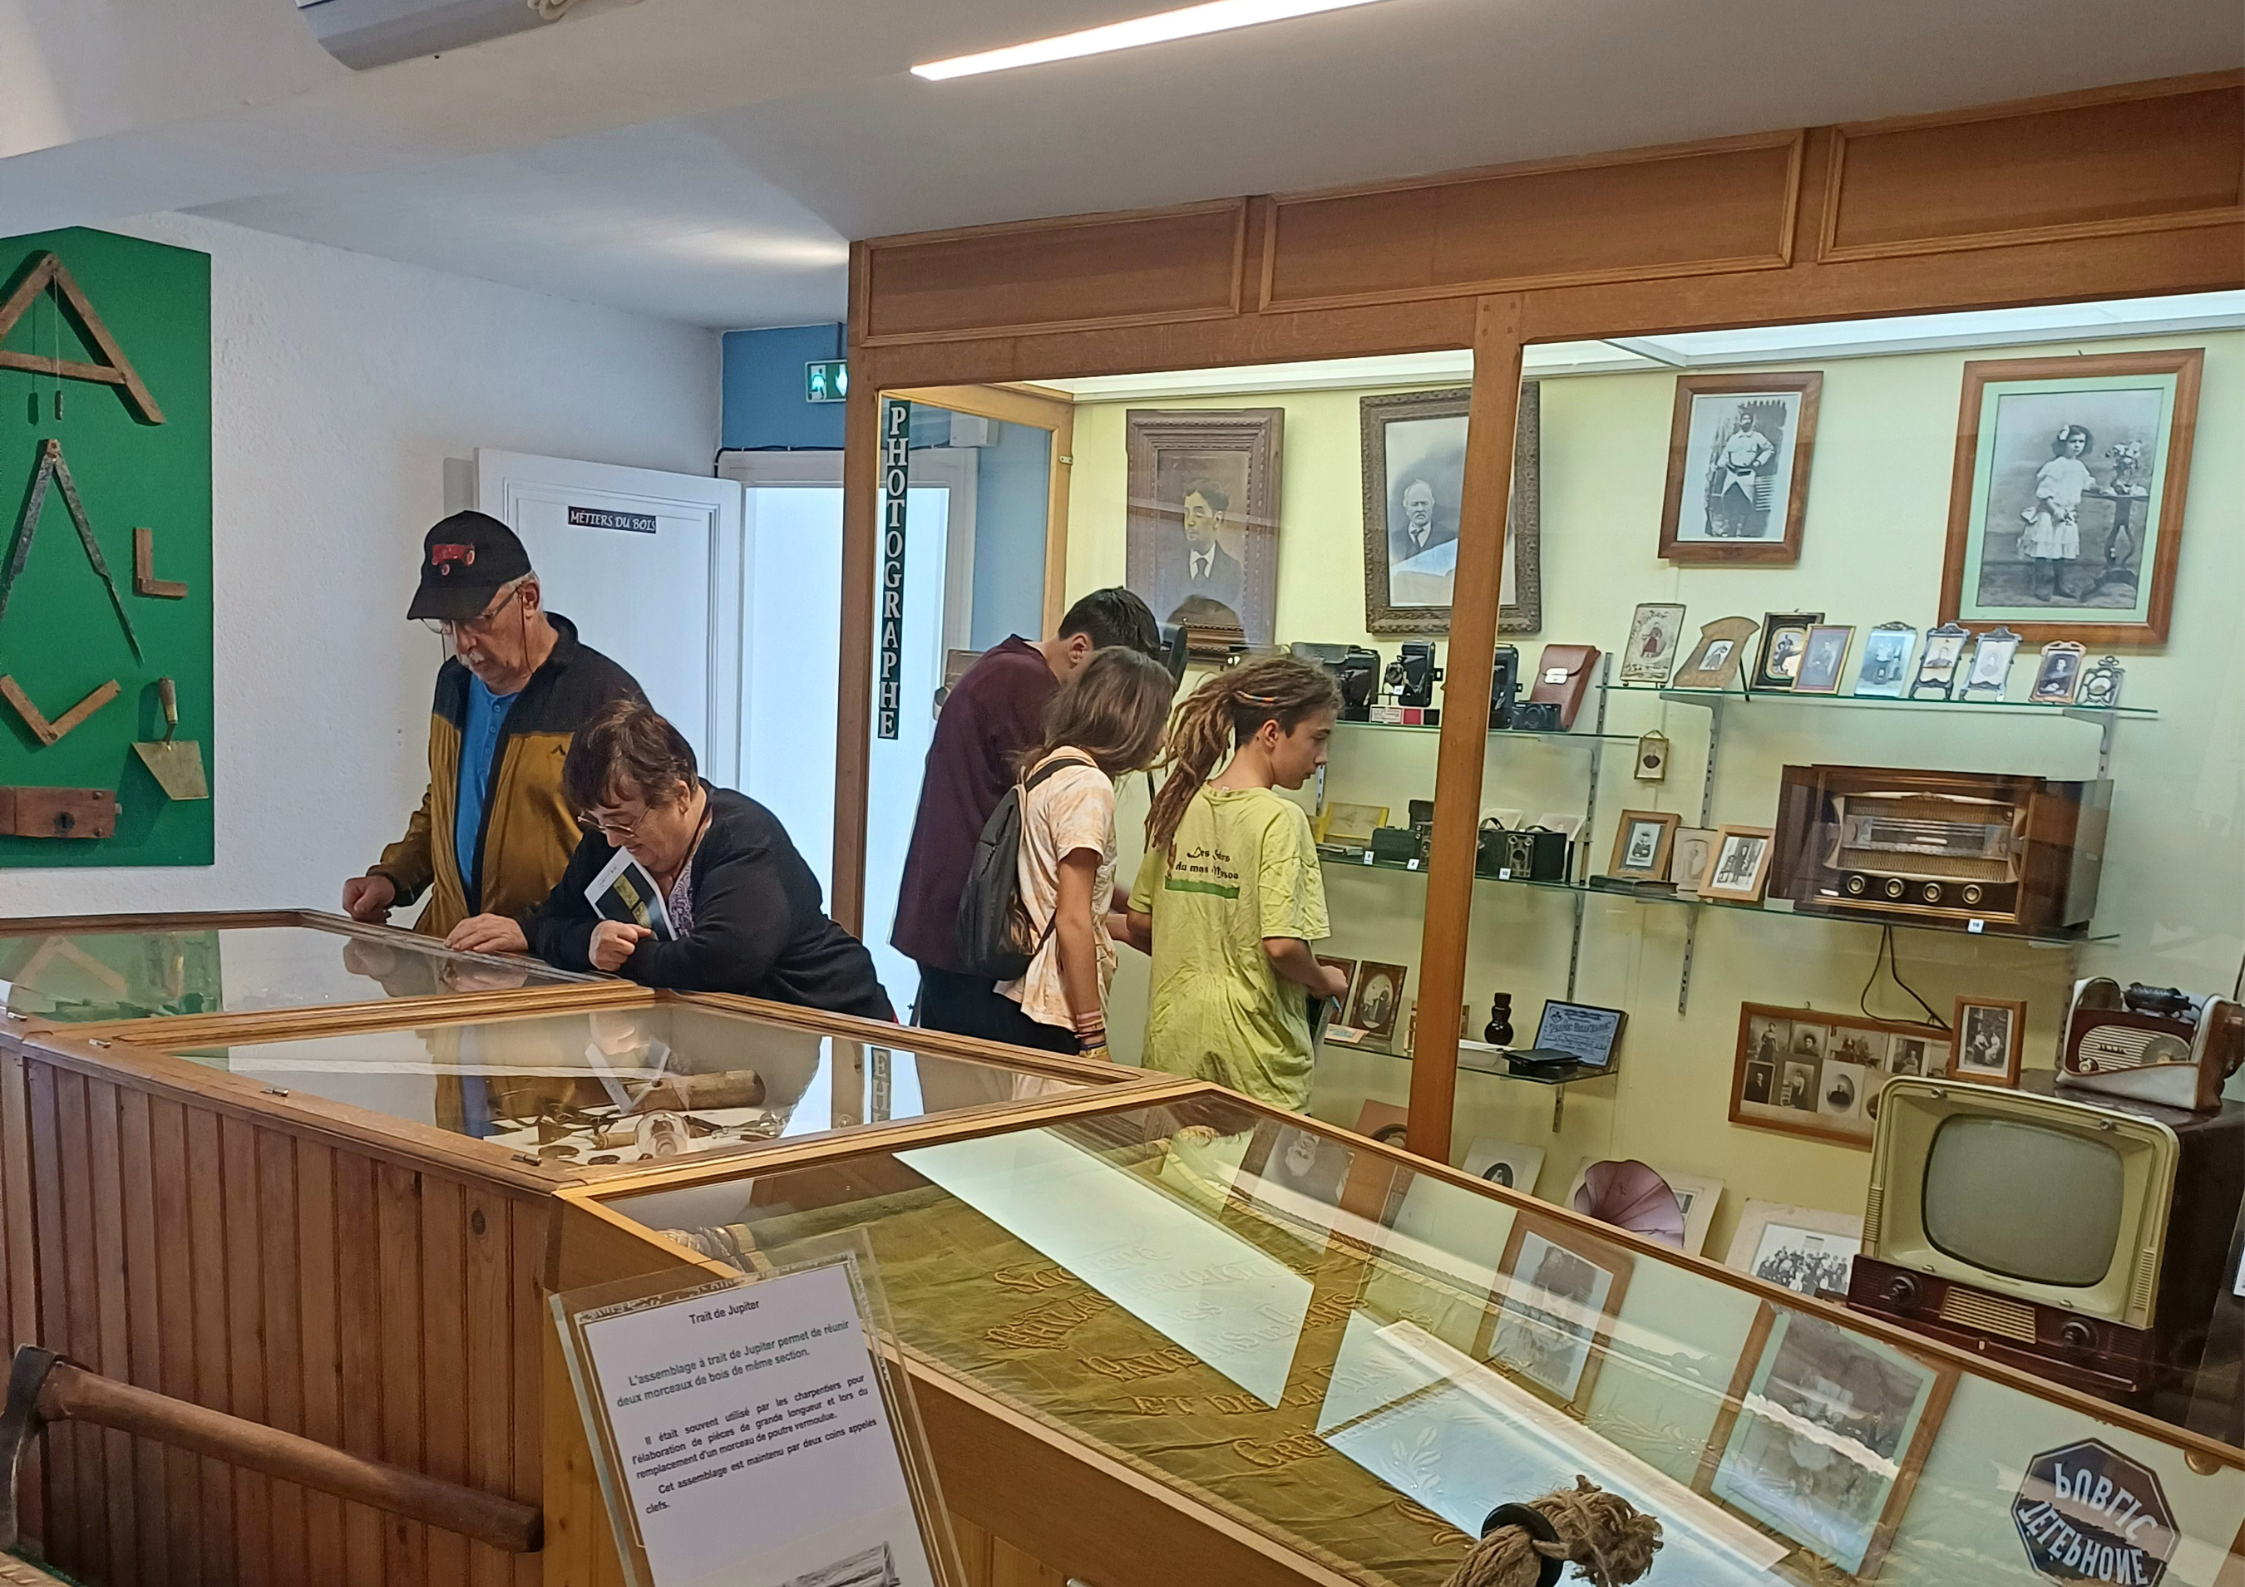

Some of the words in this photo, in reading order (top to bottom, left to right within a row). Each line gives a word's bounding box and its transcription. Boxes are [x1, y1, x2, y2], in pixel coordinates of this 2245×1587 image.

[570, 510, 613, 527] MÉTIERS
[615, 516, 631, 529] DU
[633, 518, 656, 532] BOIS
[879, 406, 909, 738] PHOTOGRAPHE
[689, 1310, 712, 1325] Trait
[714, 1306, 726, 1319] de
[728, 1300, 760, 1319] Jupiter
[616, 1393, 643, 1408] deux
[644, 1379, 694, 1400] morceaux
[695, 1374, 707, 1387] de
[708, 1368, 729, 1383] bois
[731, 1364, 744, 1377] de
[745, 1357, 773, 1373] même
[775, 1347, 811, 1365] section.
[628, 1361, 697, 1387] L'assemblage
[699, 1357, 706, 1368] à
[708, 1352, 728, 1366] trait
[729, 1348, 741, 1360] de
[744, 1339, 776, 1357] Jupiter
[777, 1330, 810, 1350] permet
[811, 1326, 822, 1338] de
[824, 1319, 850, 1335] réunir
[632, 1443, 686, 1465] l'élaboration
[691, 1437, 703, 1448] de
[708, 1428, 735, 1445] pièces
[740, 1423, 750, 1433] de
[755, 1413, 783, 1430] grande
[787, 1401, 822, 1418] longueur
[827, 1397, 836, 1406] et
[838, 1391, 854, 1402] lors
[858, 1387, 868, 1397] du
[644, 1435, 652, 1446] Il
[658, 1429, 679, 1442] était
[685, 1417, 719, 1435] souvent
[725, 1407, 750, 1422] utilisé
[756, 1402, 770, 1414] par
[775, 1397, 788, 1407] les
[794, 1381, 842, 1402] charpentiers
[847, 1375, 864, 1387] pour
[636, 1454, 699, 1480] remplacement
[699, 1448, 718, 1460] d'un
[719, 1437, 755, 1454] morceau
[755, 1433, 766, 1443] de
[768, 1425, 794, 1441] poutre
[794, 1411, 838, 1431] vermoulue.
[658, 1482, 675, 1494] Cet
[677, 1466, 728, 1489] assemblage
[730, 1461, 745, 1472] est
[746, 1448, 784, 1466] maintenu
[786, 1442, 800, 1455] par
[802, 1436, 823, 1448] deux
[824, 1428, 846, 1441] coins
[848, 1418, 877, 1435] appelés
[645, 1500, 670, 1514] clefs.
